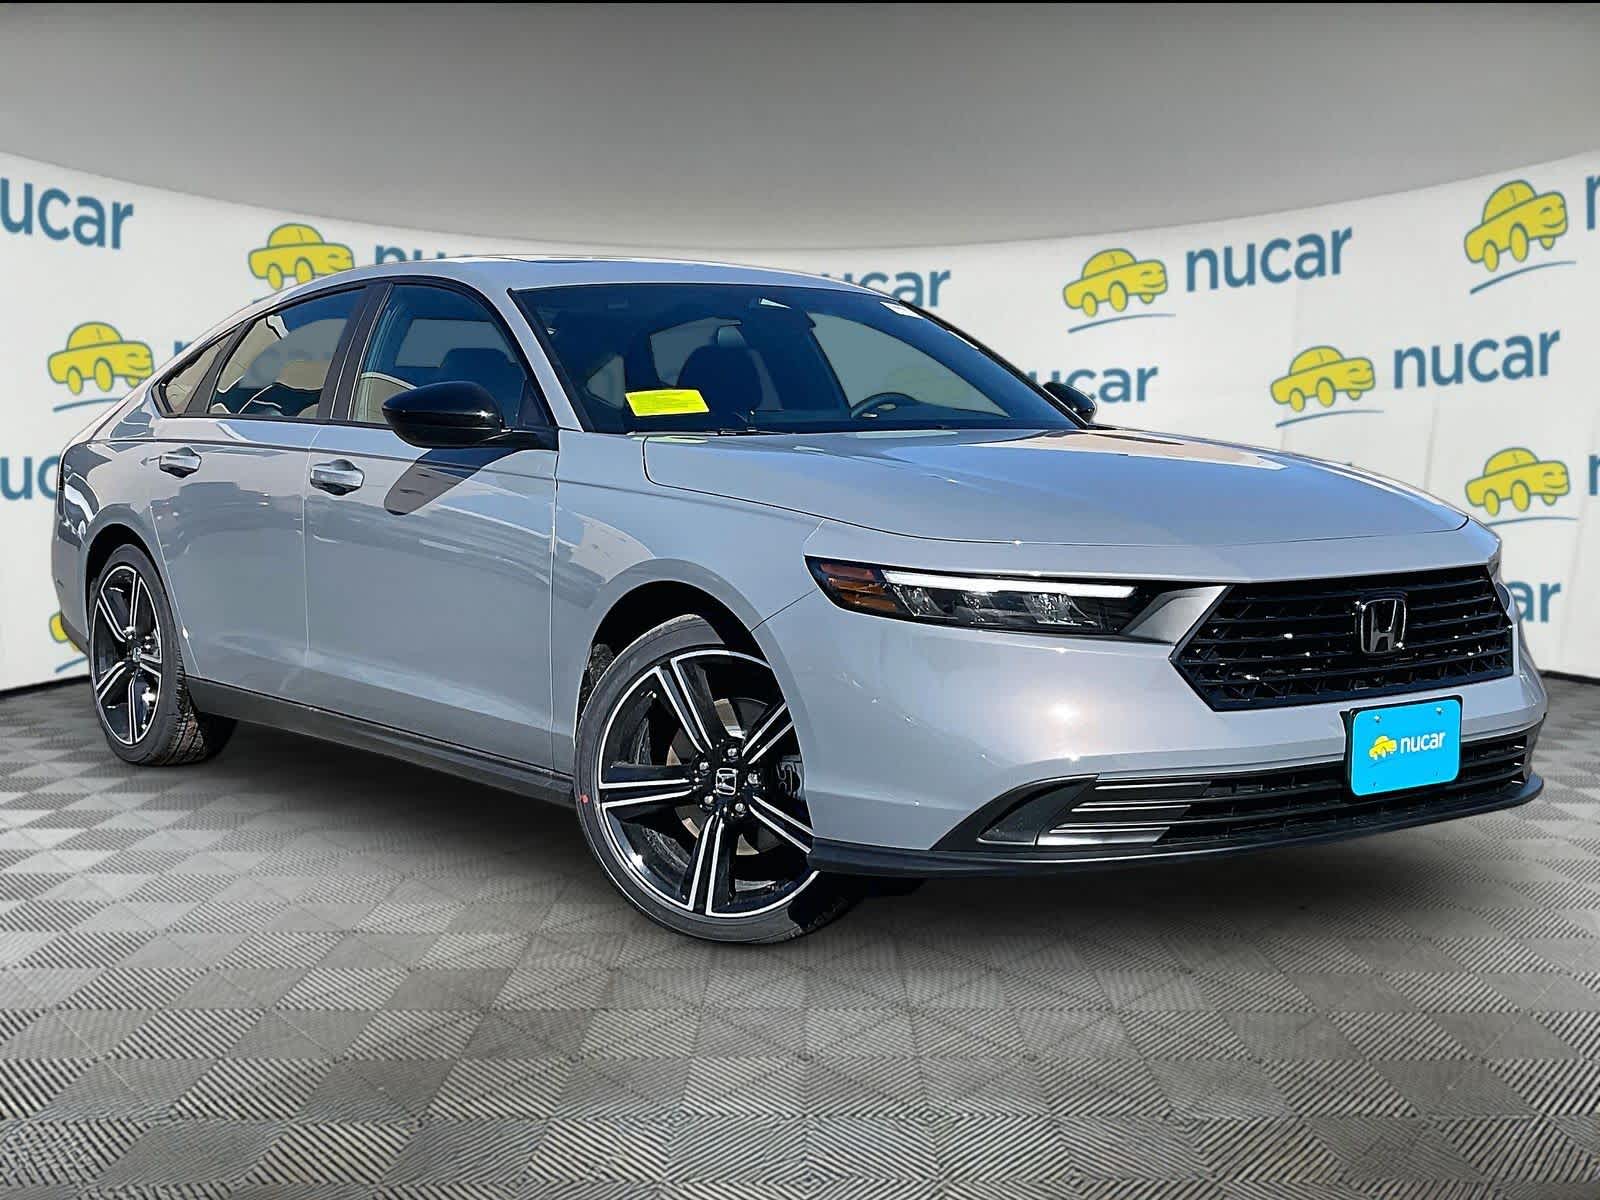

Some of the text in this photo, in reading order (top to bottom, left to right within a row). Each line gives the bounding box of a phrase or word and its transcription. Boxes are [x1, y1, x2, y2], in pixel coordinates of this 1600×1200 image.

[0, 177, 134, 250] ucar
[1186, 227, 1352, 292] nucar
[1393, 330, 1560, 389] nucar
[1400, 732, 1446, 754] nucar
